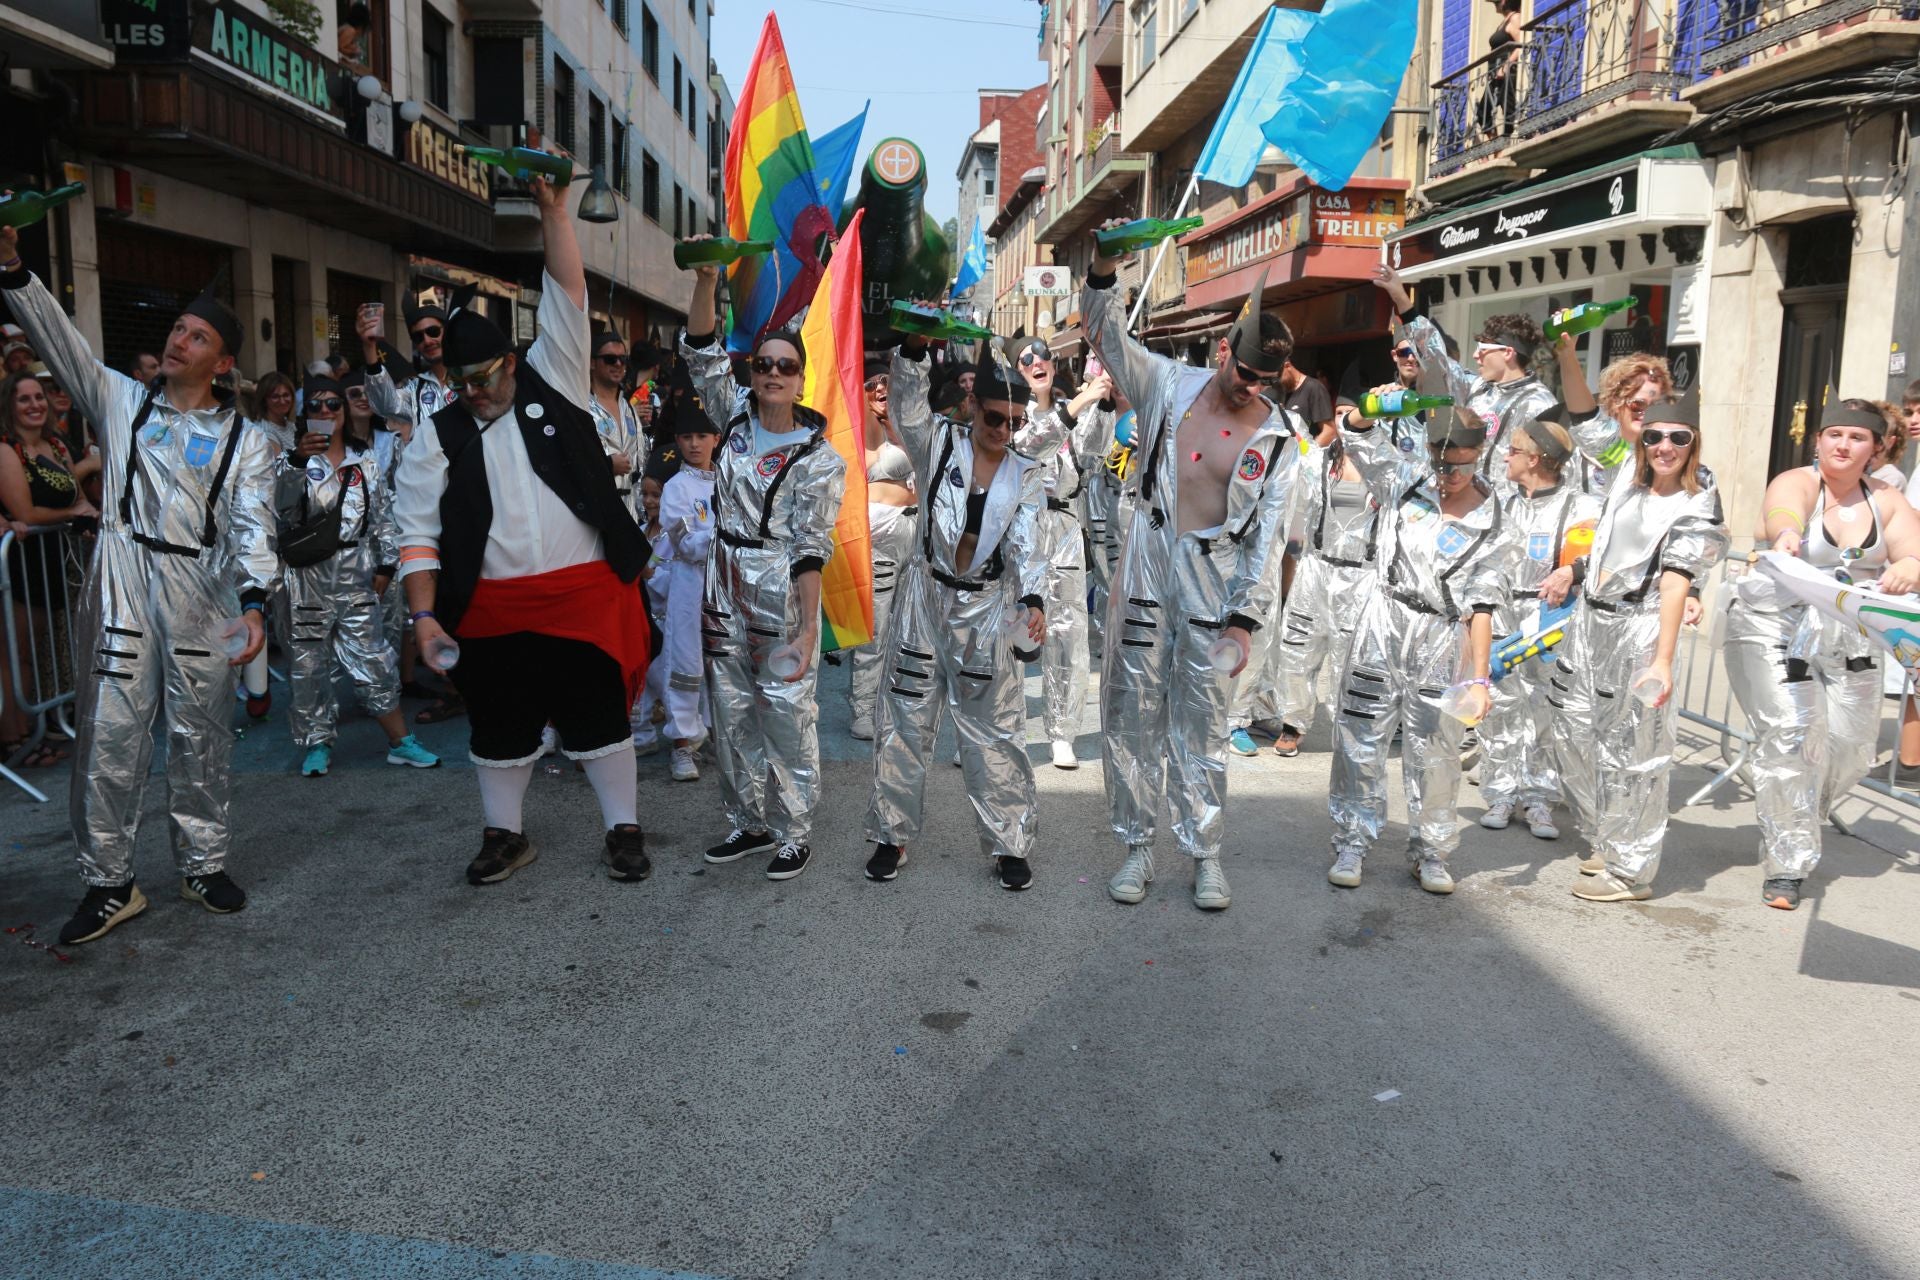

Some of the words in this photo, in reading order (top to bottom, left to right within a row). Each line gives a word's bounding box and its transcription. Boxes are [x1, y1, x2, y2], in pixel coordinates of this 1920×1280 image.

[211, 8, 331, 111] ARMERIA
[1316, 195, 1351, 209] CASA
[1315, 219, 1399, 238] TRELLES
[1494, 210, 1549, 238] Despacio
[1226, 212, 1283, 269] TRELLES
[868, 281, 895, 300] EL
